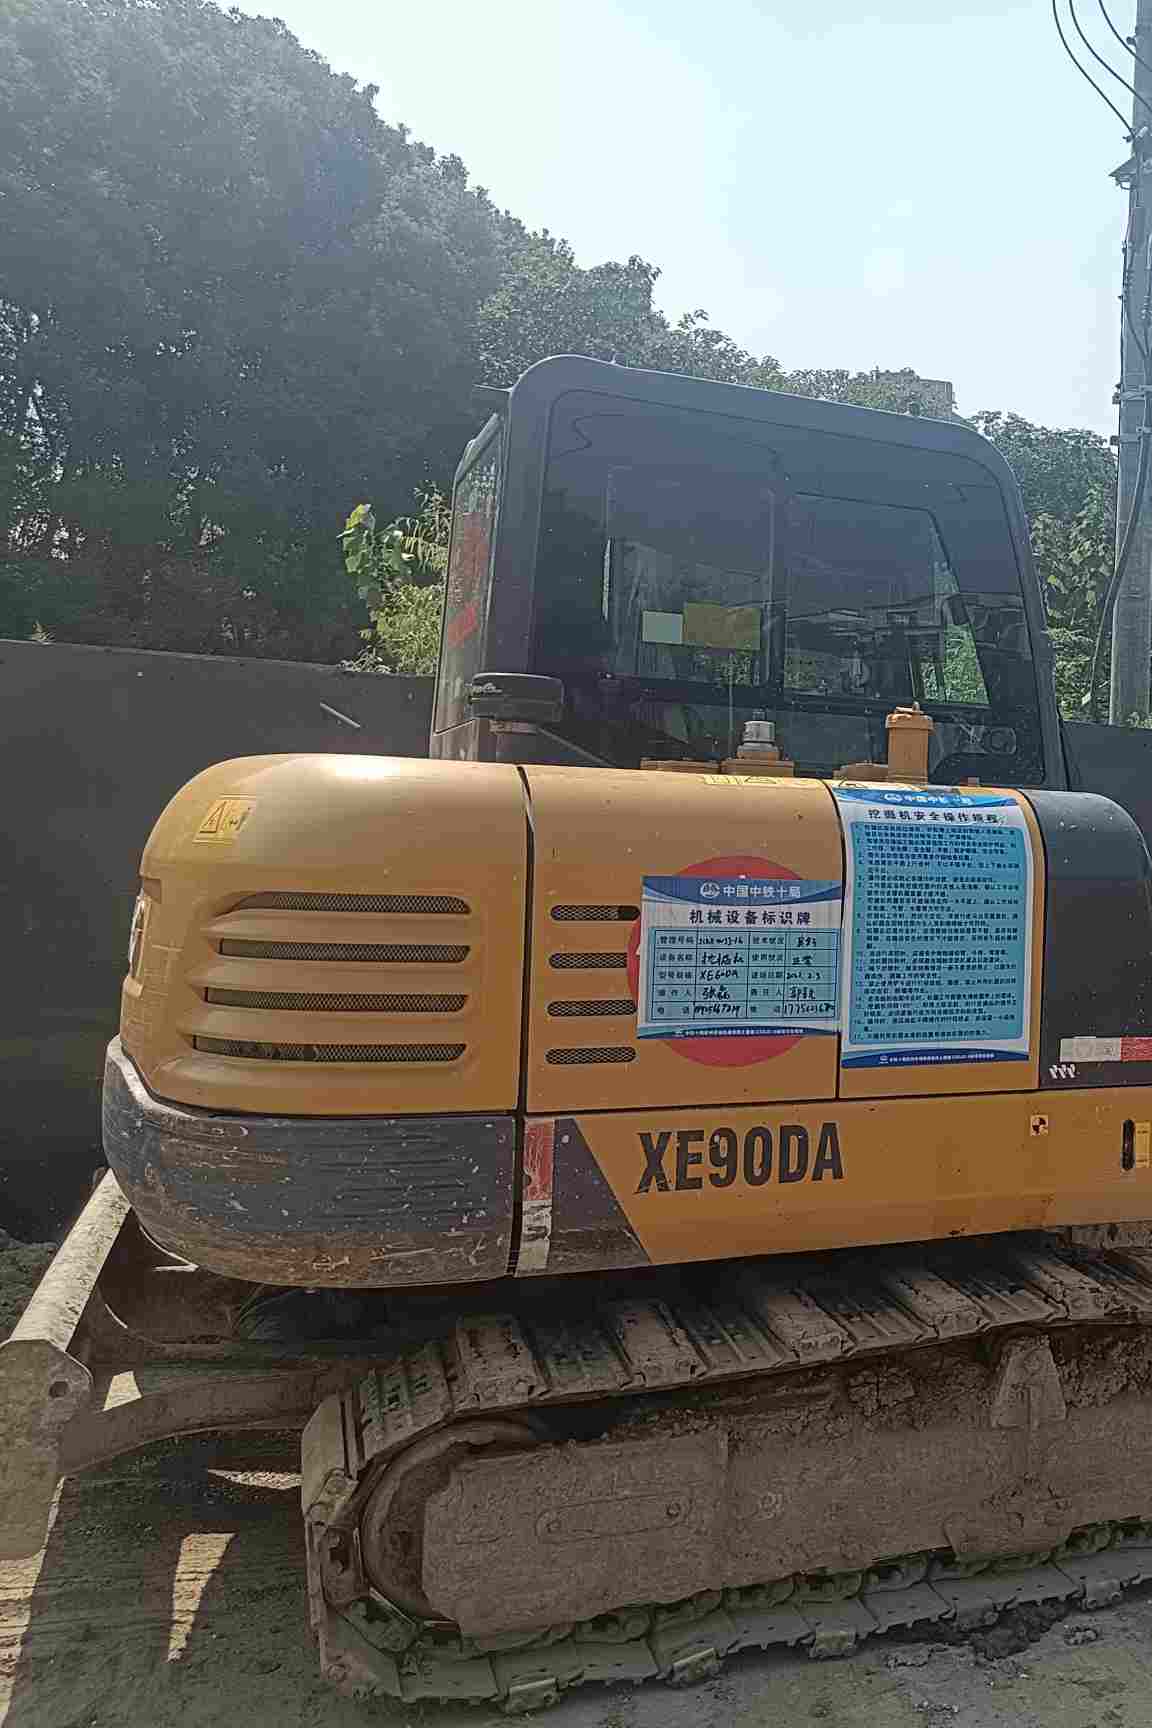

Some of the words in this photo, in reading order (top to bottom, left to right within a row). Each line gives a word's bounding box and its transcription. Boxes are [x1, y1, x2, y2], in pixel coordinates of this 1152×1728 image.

[689, 910, 812, 925] 机械设备标识牌
[634, 1121, 844, 1194] XE90DA
